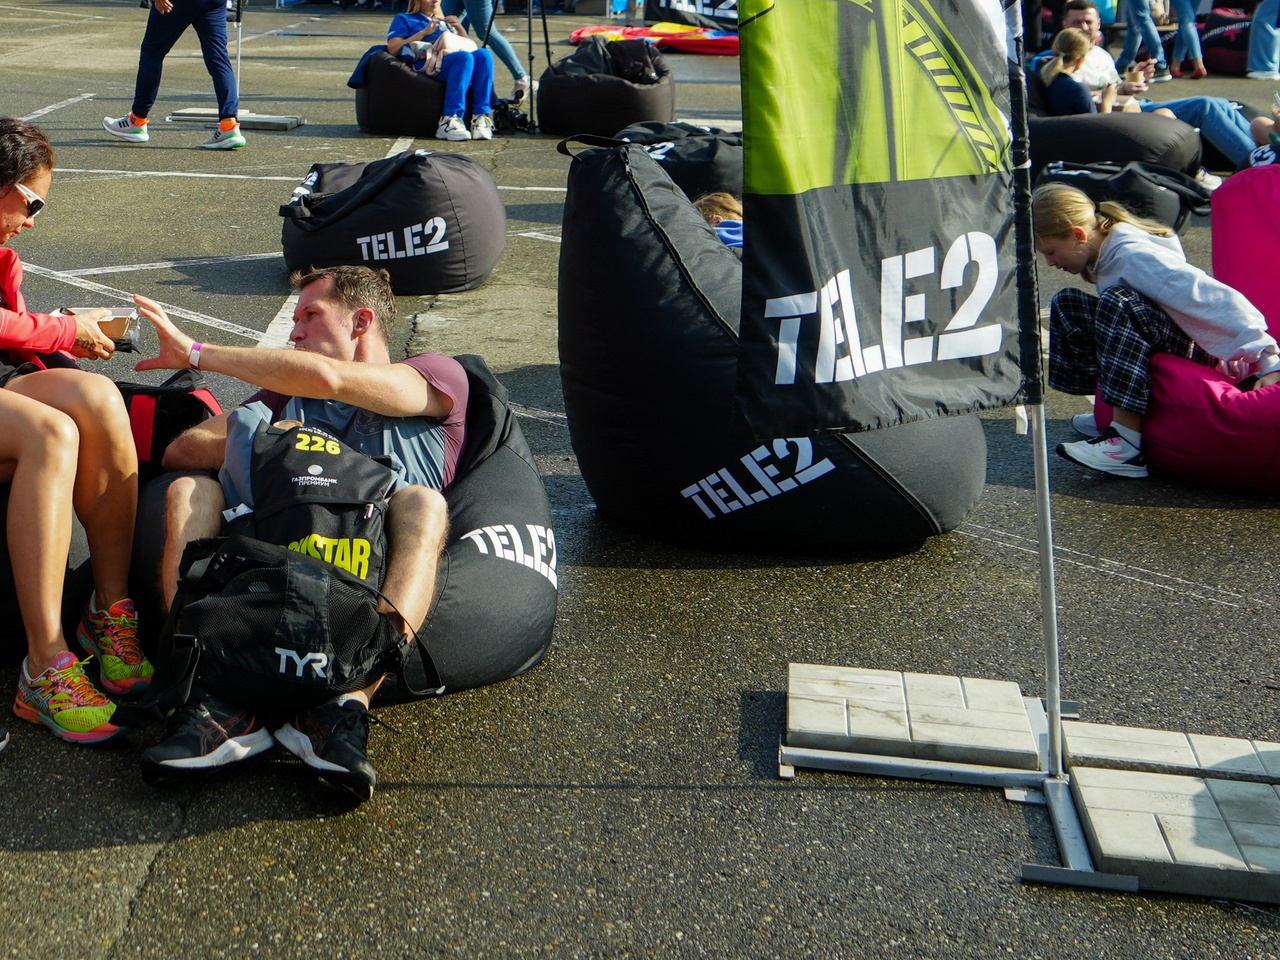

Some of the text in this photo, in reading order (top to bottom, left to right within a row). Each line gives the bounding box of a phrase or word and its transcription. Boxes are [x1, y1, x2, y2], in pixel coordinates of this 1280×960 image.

[356, 216, 450, 261] TELE2
[764, 230, 1003, 385] TELE2
[295, 433, 341, 455] 226
[291, 476, 338, 484] ГАЗПРОМБАНК
[679, 436, 837, 520] TELE2
[274, 646, 328, 679] TYR
